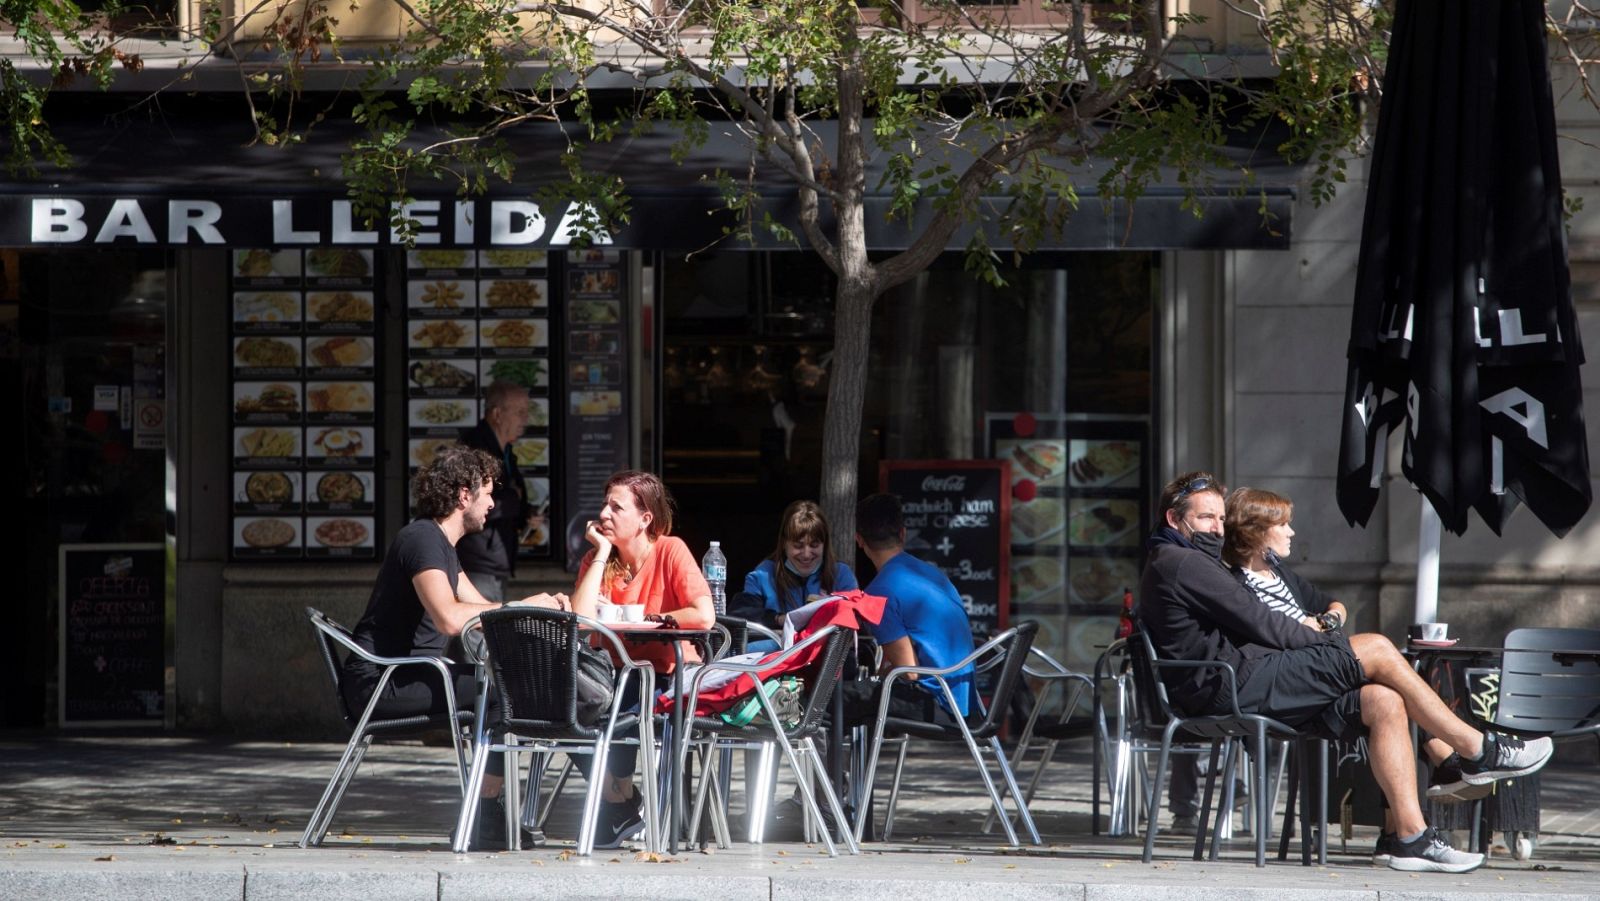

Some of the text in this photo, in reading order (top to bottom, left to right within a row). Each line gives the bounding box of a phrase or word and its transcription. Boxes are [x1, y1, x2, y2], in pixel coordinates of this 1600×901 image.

[31, 198, 613, 246] BAR LLEIDA
[902, 499, 952, 513] andwich
